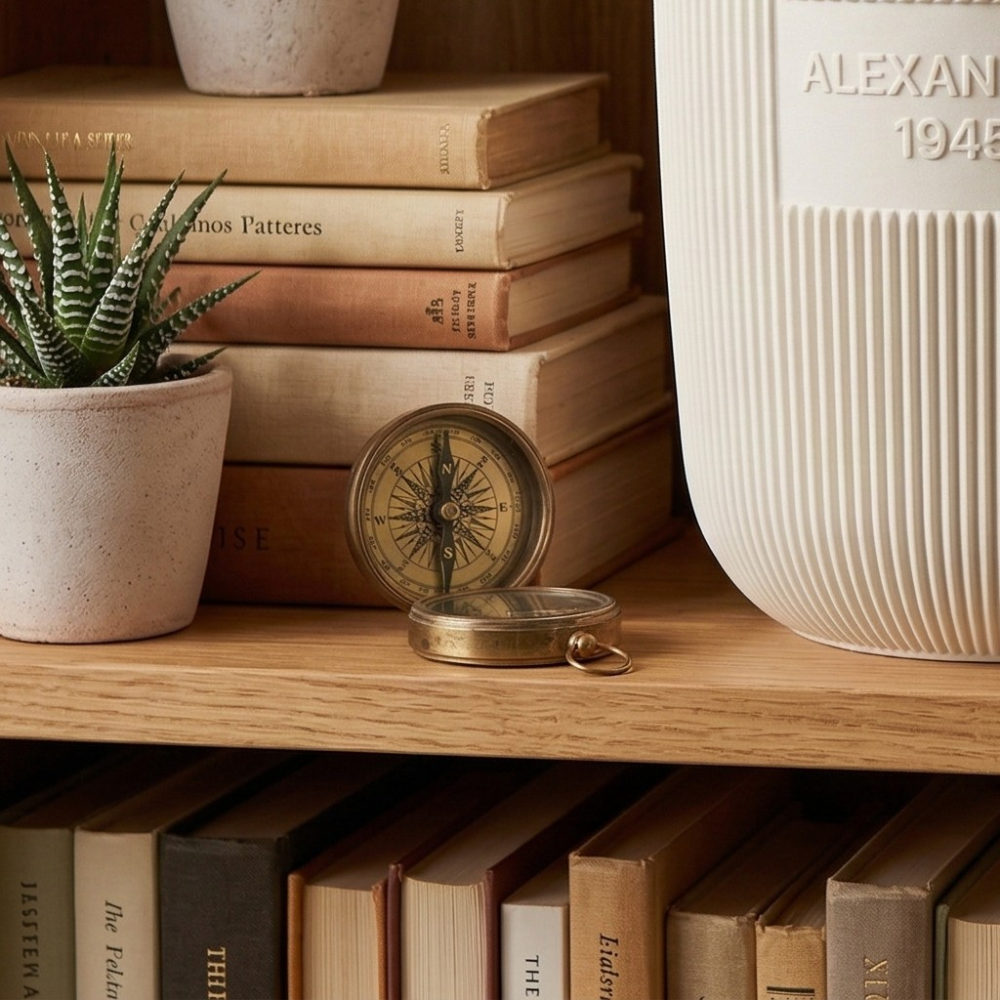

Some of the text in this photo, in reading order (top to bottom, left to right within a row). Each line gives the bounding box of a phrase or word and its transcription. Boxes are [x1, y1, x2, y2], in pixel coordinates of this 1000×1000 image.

[240, 214, 323, 237] Patteres
[442, 463, 453, 475] N
[374, 515, 387, 526] W
[443, 546, 454, 560] S
[525, 955, 540, 998] THE
